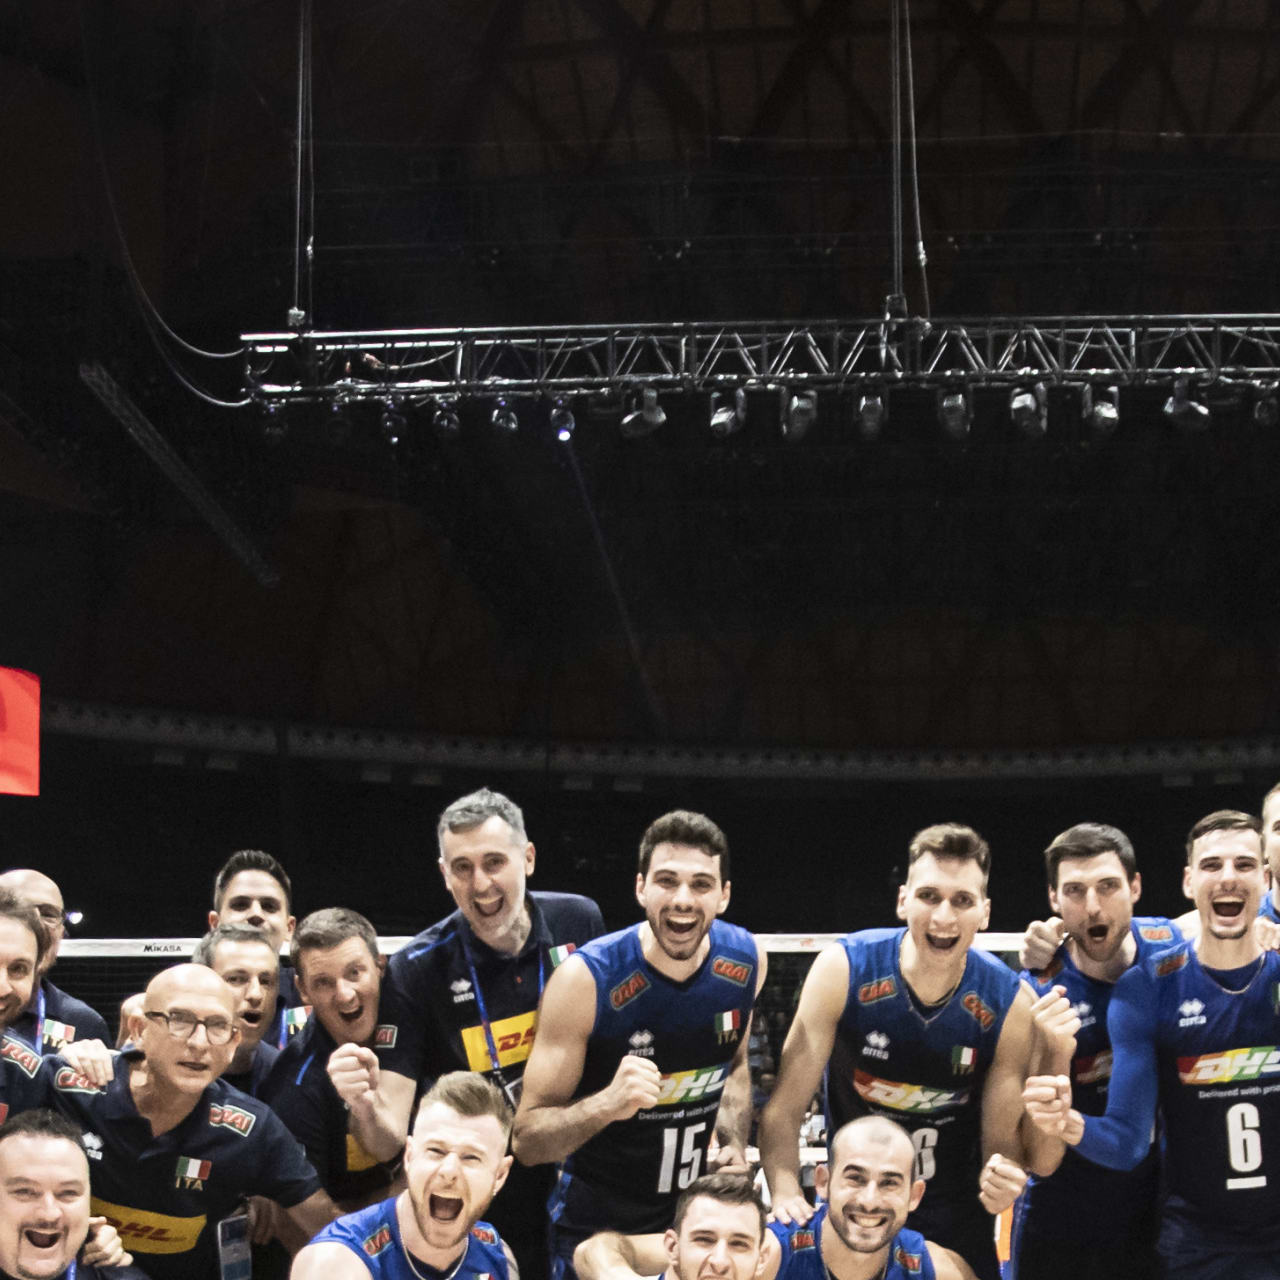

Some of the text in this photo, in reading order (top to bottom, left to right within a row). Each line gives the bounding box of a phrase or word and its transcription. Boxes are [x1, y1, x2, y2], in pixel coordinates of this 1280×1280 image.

[713, 958, 748, 982] CRAI
[612, 972, 646, 1006] CRAI
[718, 1029, 739, 1046] ITA
[862, 1046, 889, 1060] errea
[1240, 1084, 1262, 1097] with
[638, 1110, 685, 1121] Delivered
[1225, 1102, 1262, 1173] 6
[657, 1121, 706, 1194] 15
[175, 1177, 204, 1192] ITA
